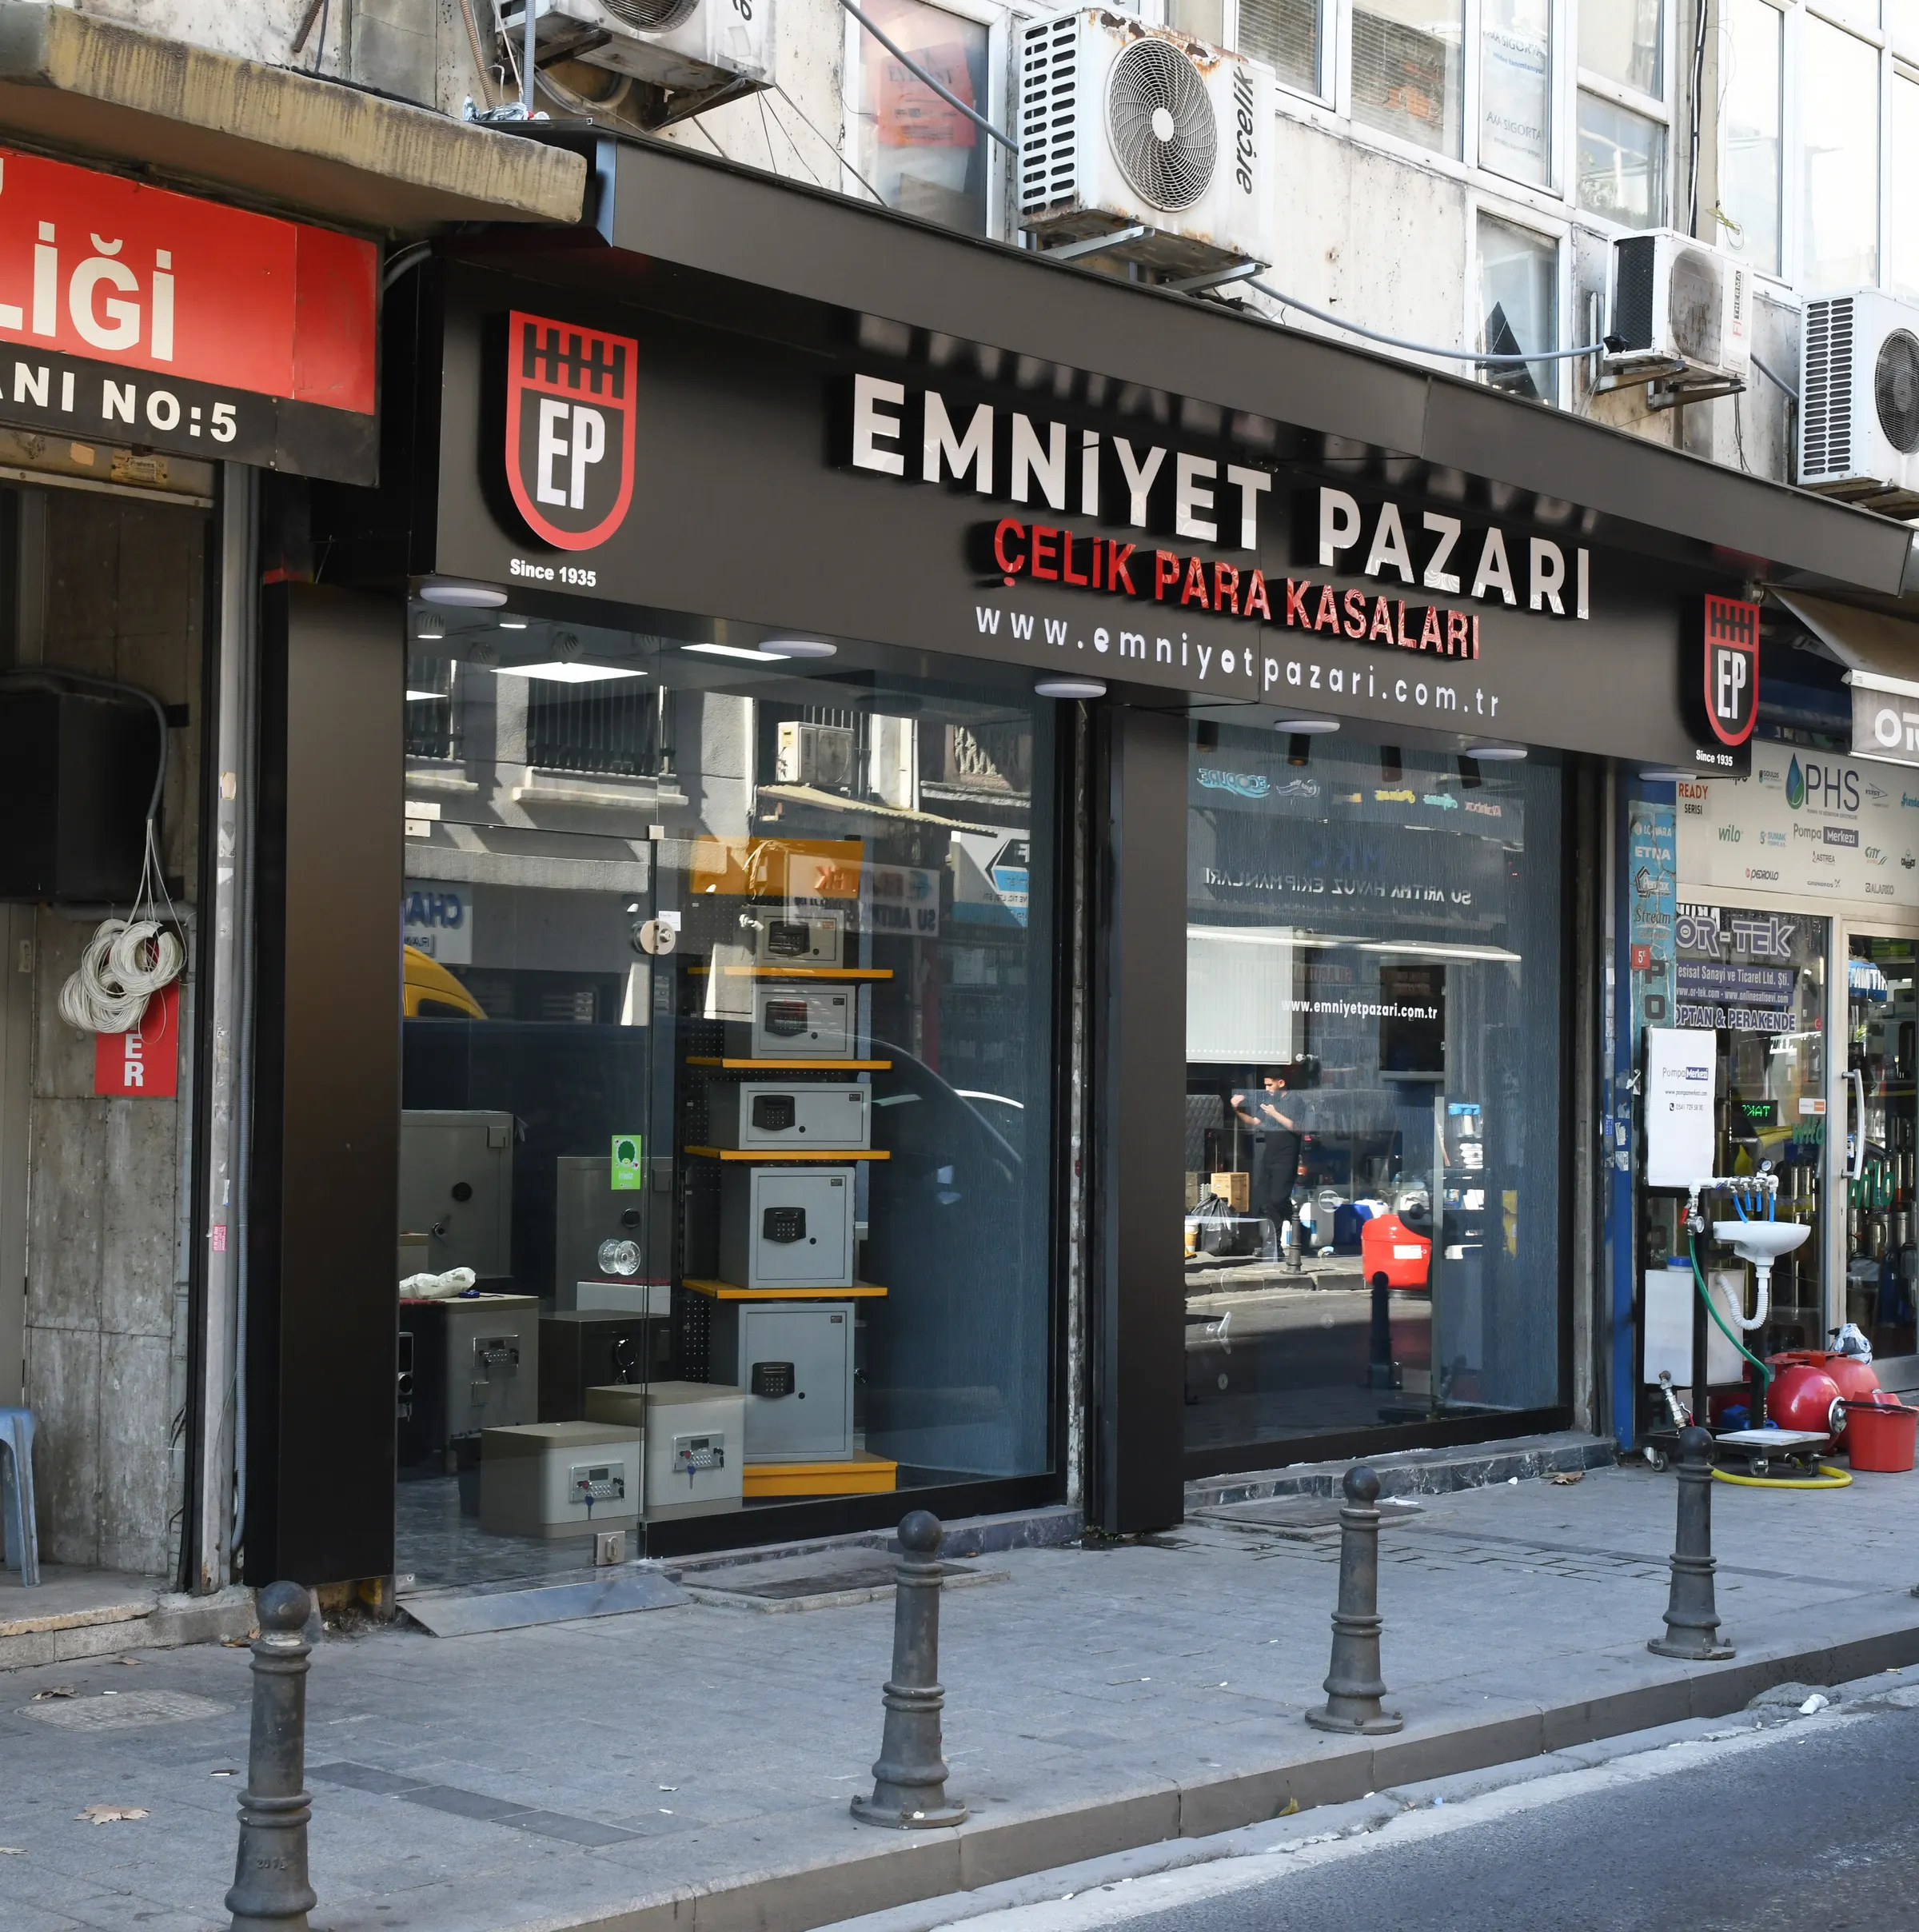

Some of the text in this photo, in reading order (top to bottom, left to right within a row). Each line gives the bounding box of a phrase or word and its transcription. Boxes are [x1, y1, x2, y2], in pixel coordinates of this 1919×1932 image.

[1233, 66, 1257, 194] arçelik
[0, 361, 237, 442] NI NO:5
[537, 398, 605, 509] EP
[852, 373, 1590, 620] EMNİYET PAZARI
[510, 558, 596, 587] Since 1935
[994, 517, 1479, 660] ÇELİK PARA KASALARI
[975, 606, 1499, 717] www.emniyetpazari.com.tr
[1718, 649, 1746, 720] EP
[1695, 749, 1733, 766] Since 1935
[1679, 783, 1708, 800] READY
[1805, 764, 1860, 812] PHS
[1718, 824, 1741, 843] wilo
[1793, 823, 1855, 844] Pompa Merkezi
[1635, 908, 1670, 924] Stream
[1676, 915, 1796, 957] OR-TEK
[1676, 964, 1789, 988] esisat Sanayi ve Ticaret Ltd. Şti.
[1281, 1000, 1438, 1020] www.emniyetpazari.com.tr
[1715, 1007, 1726, 1029] &
[1727, 1008, 1797, 1032] PERAKENDE
[124, 1026, 144, 1087] ER
[1662, 1067, 1685, 1080] Pompa
